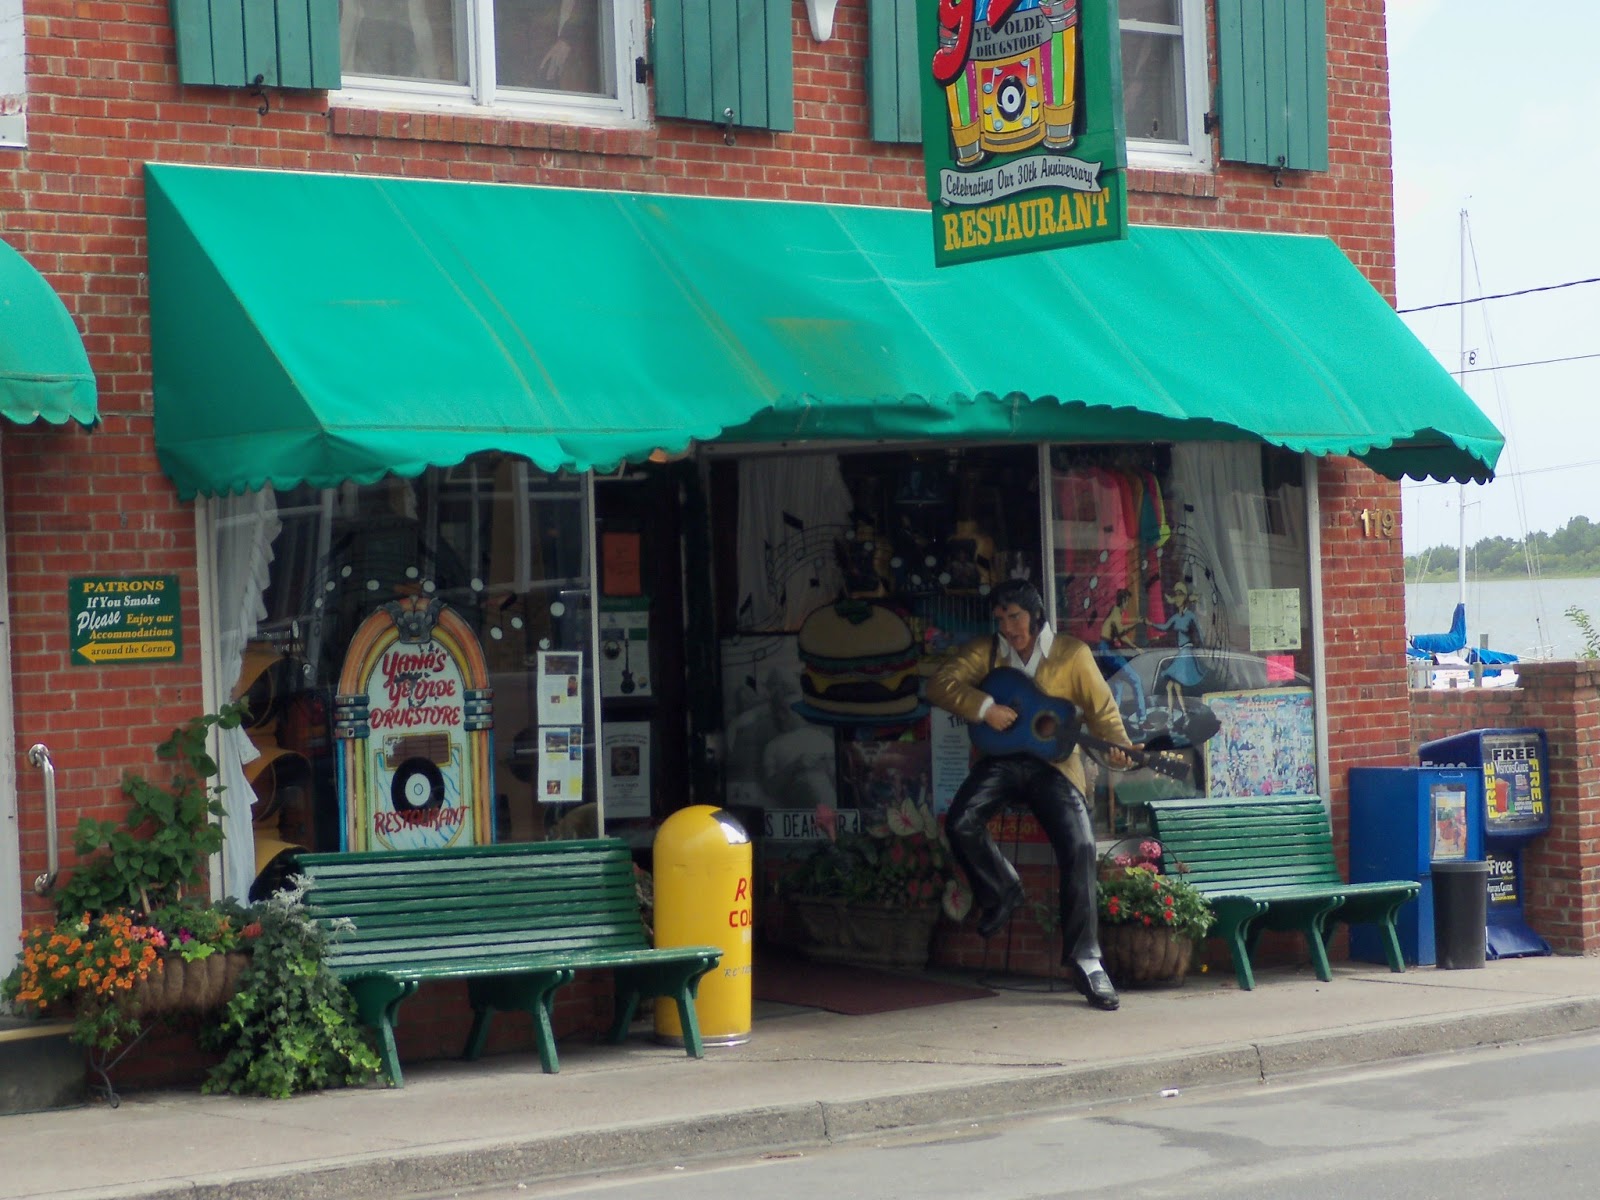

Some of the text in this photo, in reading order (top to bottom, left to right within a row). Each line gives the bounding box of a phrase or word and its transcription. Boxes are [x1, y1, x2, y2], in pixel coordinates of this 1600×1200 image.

[975, 14, 1045, 43] YE OLDE
[976, 32, 1043, 57] DRUGSTORE
[946, 158, 1094, 197] Celebrating Our 30th Anniversary
[942, 187, 1110, 252] RESTAURANT
[1361, 508, 1395, 537] 119
[83, 580, 165, 593] PATRONS
[86, 594, 161, 609] If You Smoke
[76, 610, 174, 636] Please Enjoy our
[89, 626, 174, 640] Accommodations
[91, 643, 172, 656] around the Corner
[388, 679, 456, 709] YE OLDE
[370, 704, 461, 729] DRUGSTORE
[1492, 748, 1536, 762] FREE
[1483, 761, 1498, 819] FREE
[1528, 758, 1544, 815] FREE
[374, 806, 470, 836] RESTAURANT
[1489, 859, 1514, 876] Free
